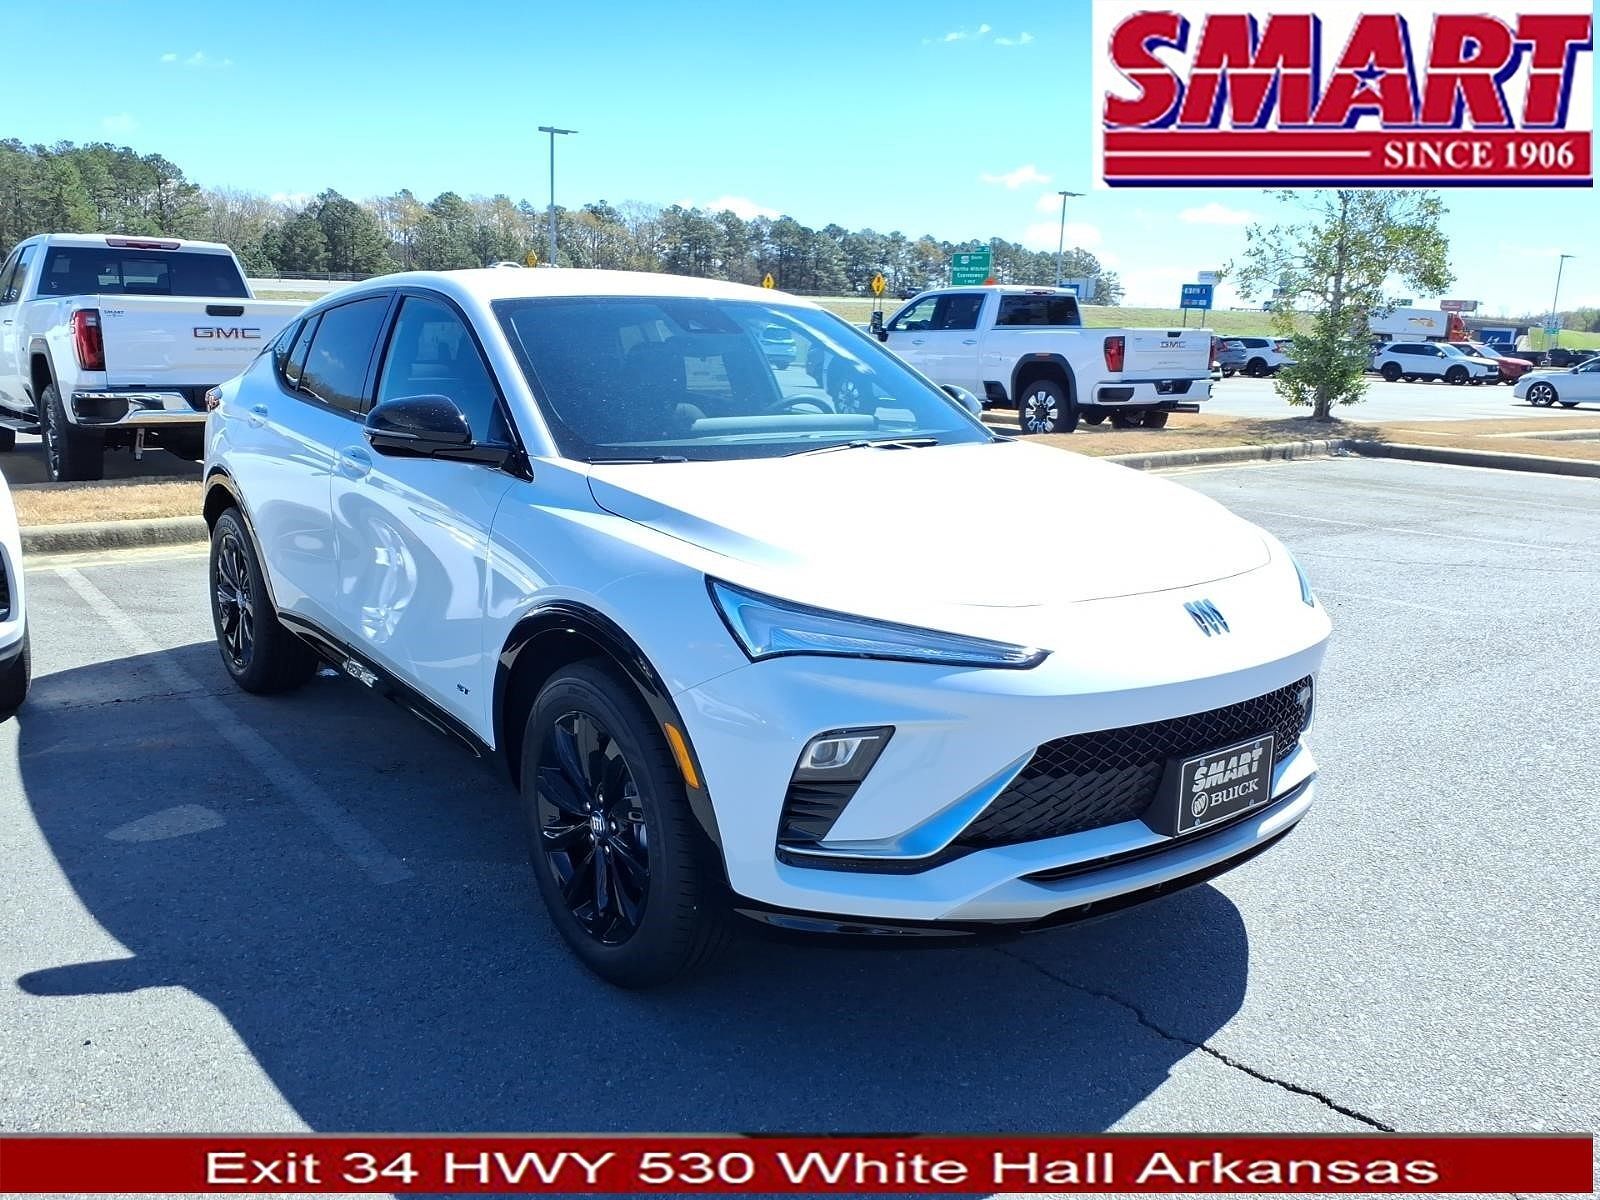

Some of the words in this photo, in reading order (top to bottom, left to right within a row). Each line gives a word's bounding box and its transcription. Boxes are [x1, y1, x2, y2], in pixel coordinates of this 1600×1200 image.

[192, 326, 262, 339] GMC
[1159, 340, 1187, 349] GMC
[1191, 747, 1264, 793] SMART
[1209, 778, 1260, 807] BUICK
